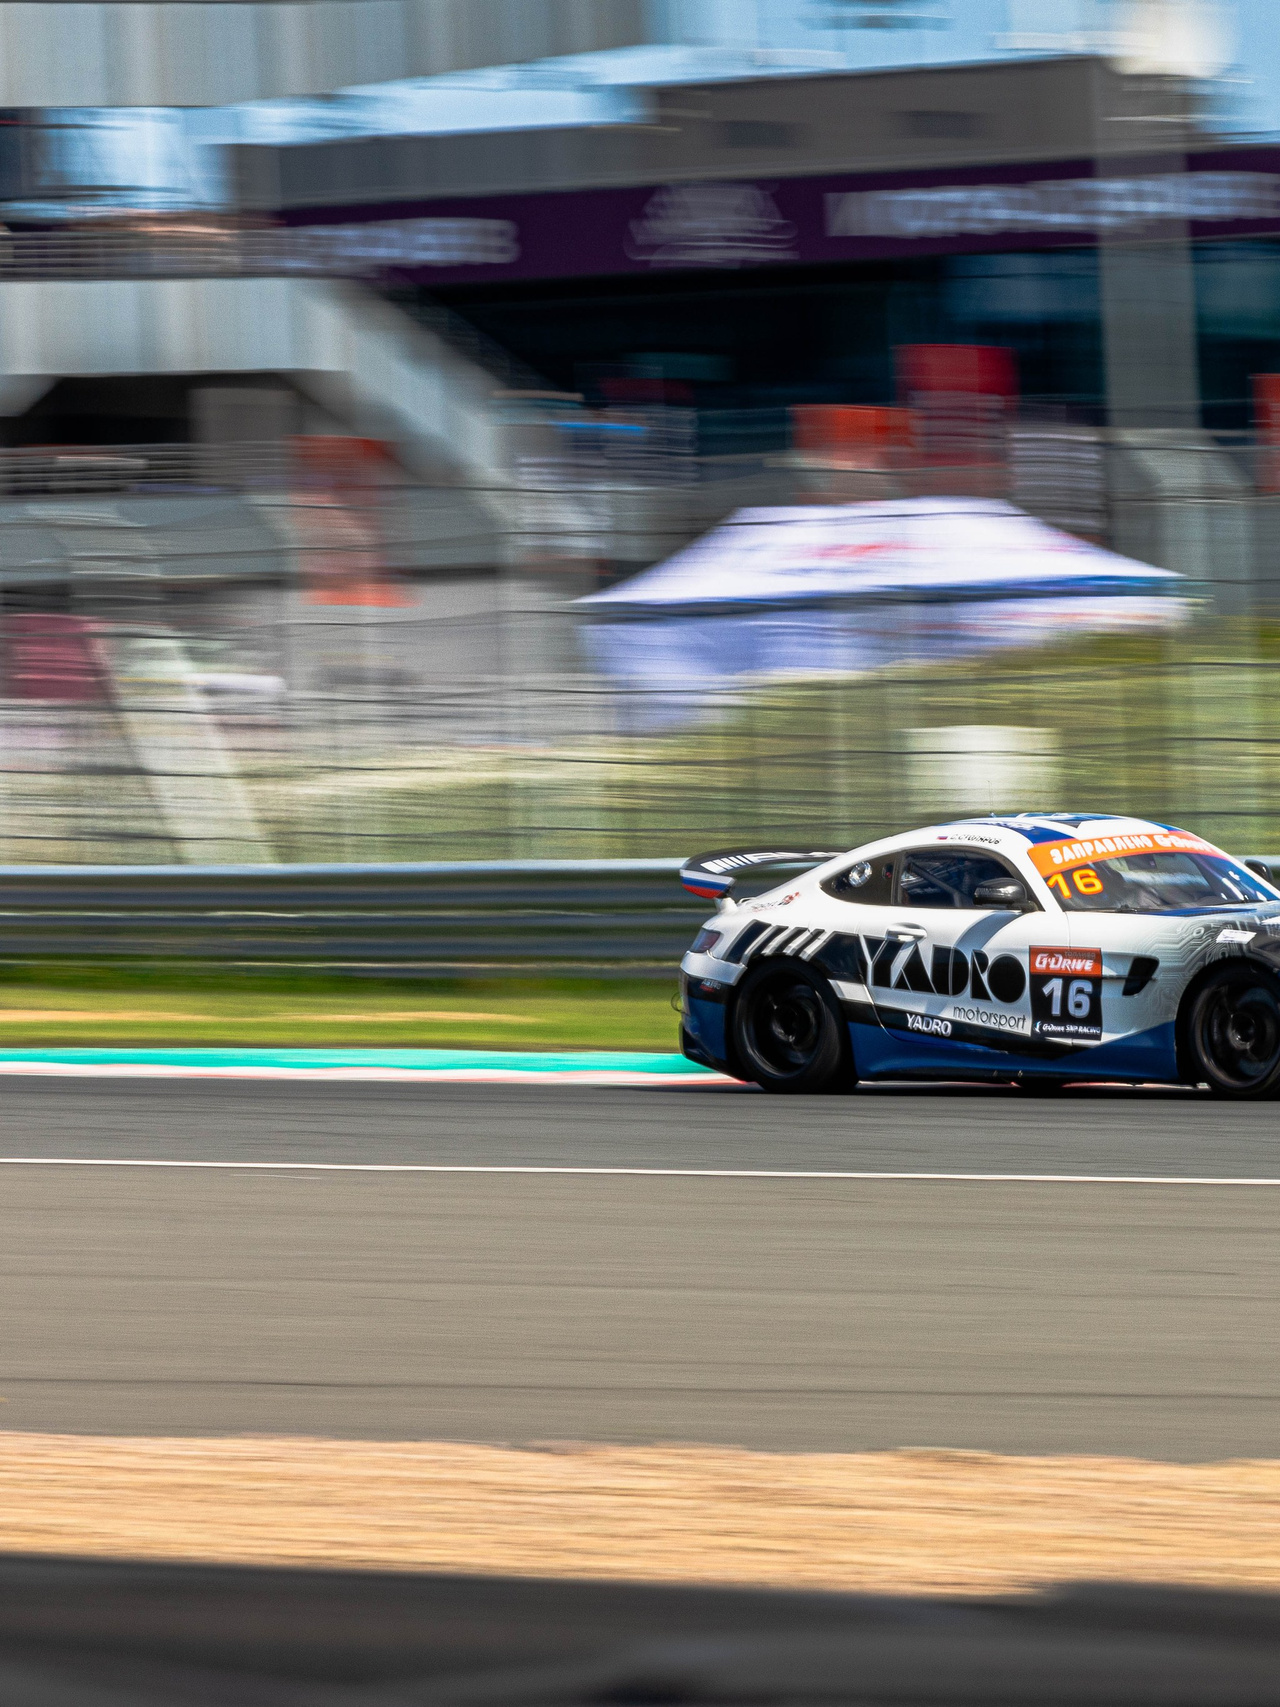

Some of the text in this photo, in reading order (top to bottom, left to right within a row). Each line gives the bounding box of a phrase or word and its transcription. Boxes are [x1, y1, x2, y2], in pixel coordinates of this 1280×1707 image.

[1049, 834, 1154, 865] ЗАПРАВЛЕНО
[1046, 868, 1104, 900] 16
[861, 934, 1027, 1004] YADRO
[1042, 978, 1093, 1019] 16
[906, 1013, 953, 1037] YADRO
[953, 1005, 1027, 1030] motorsport
